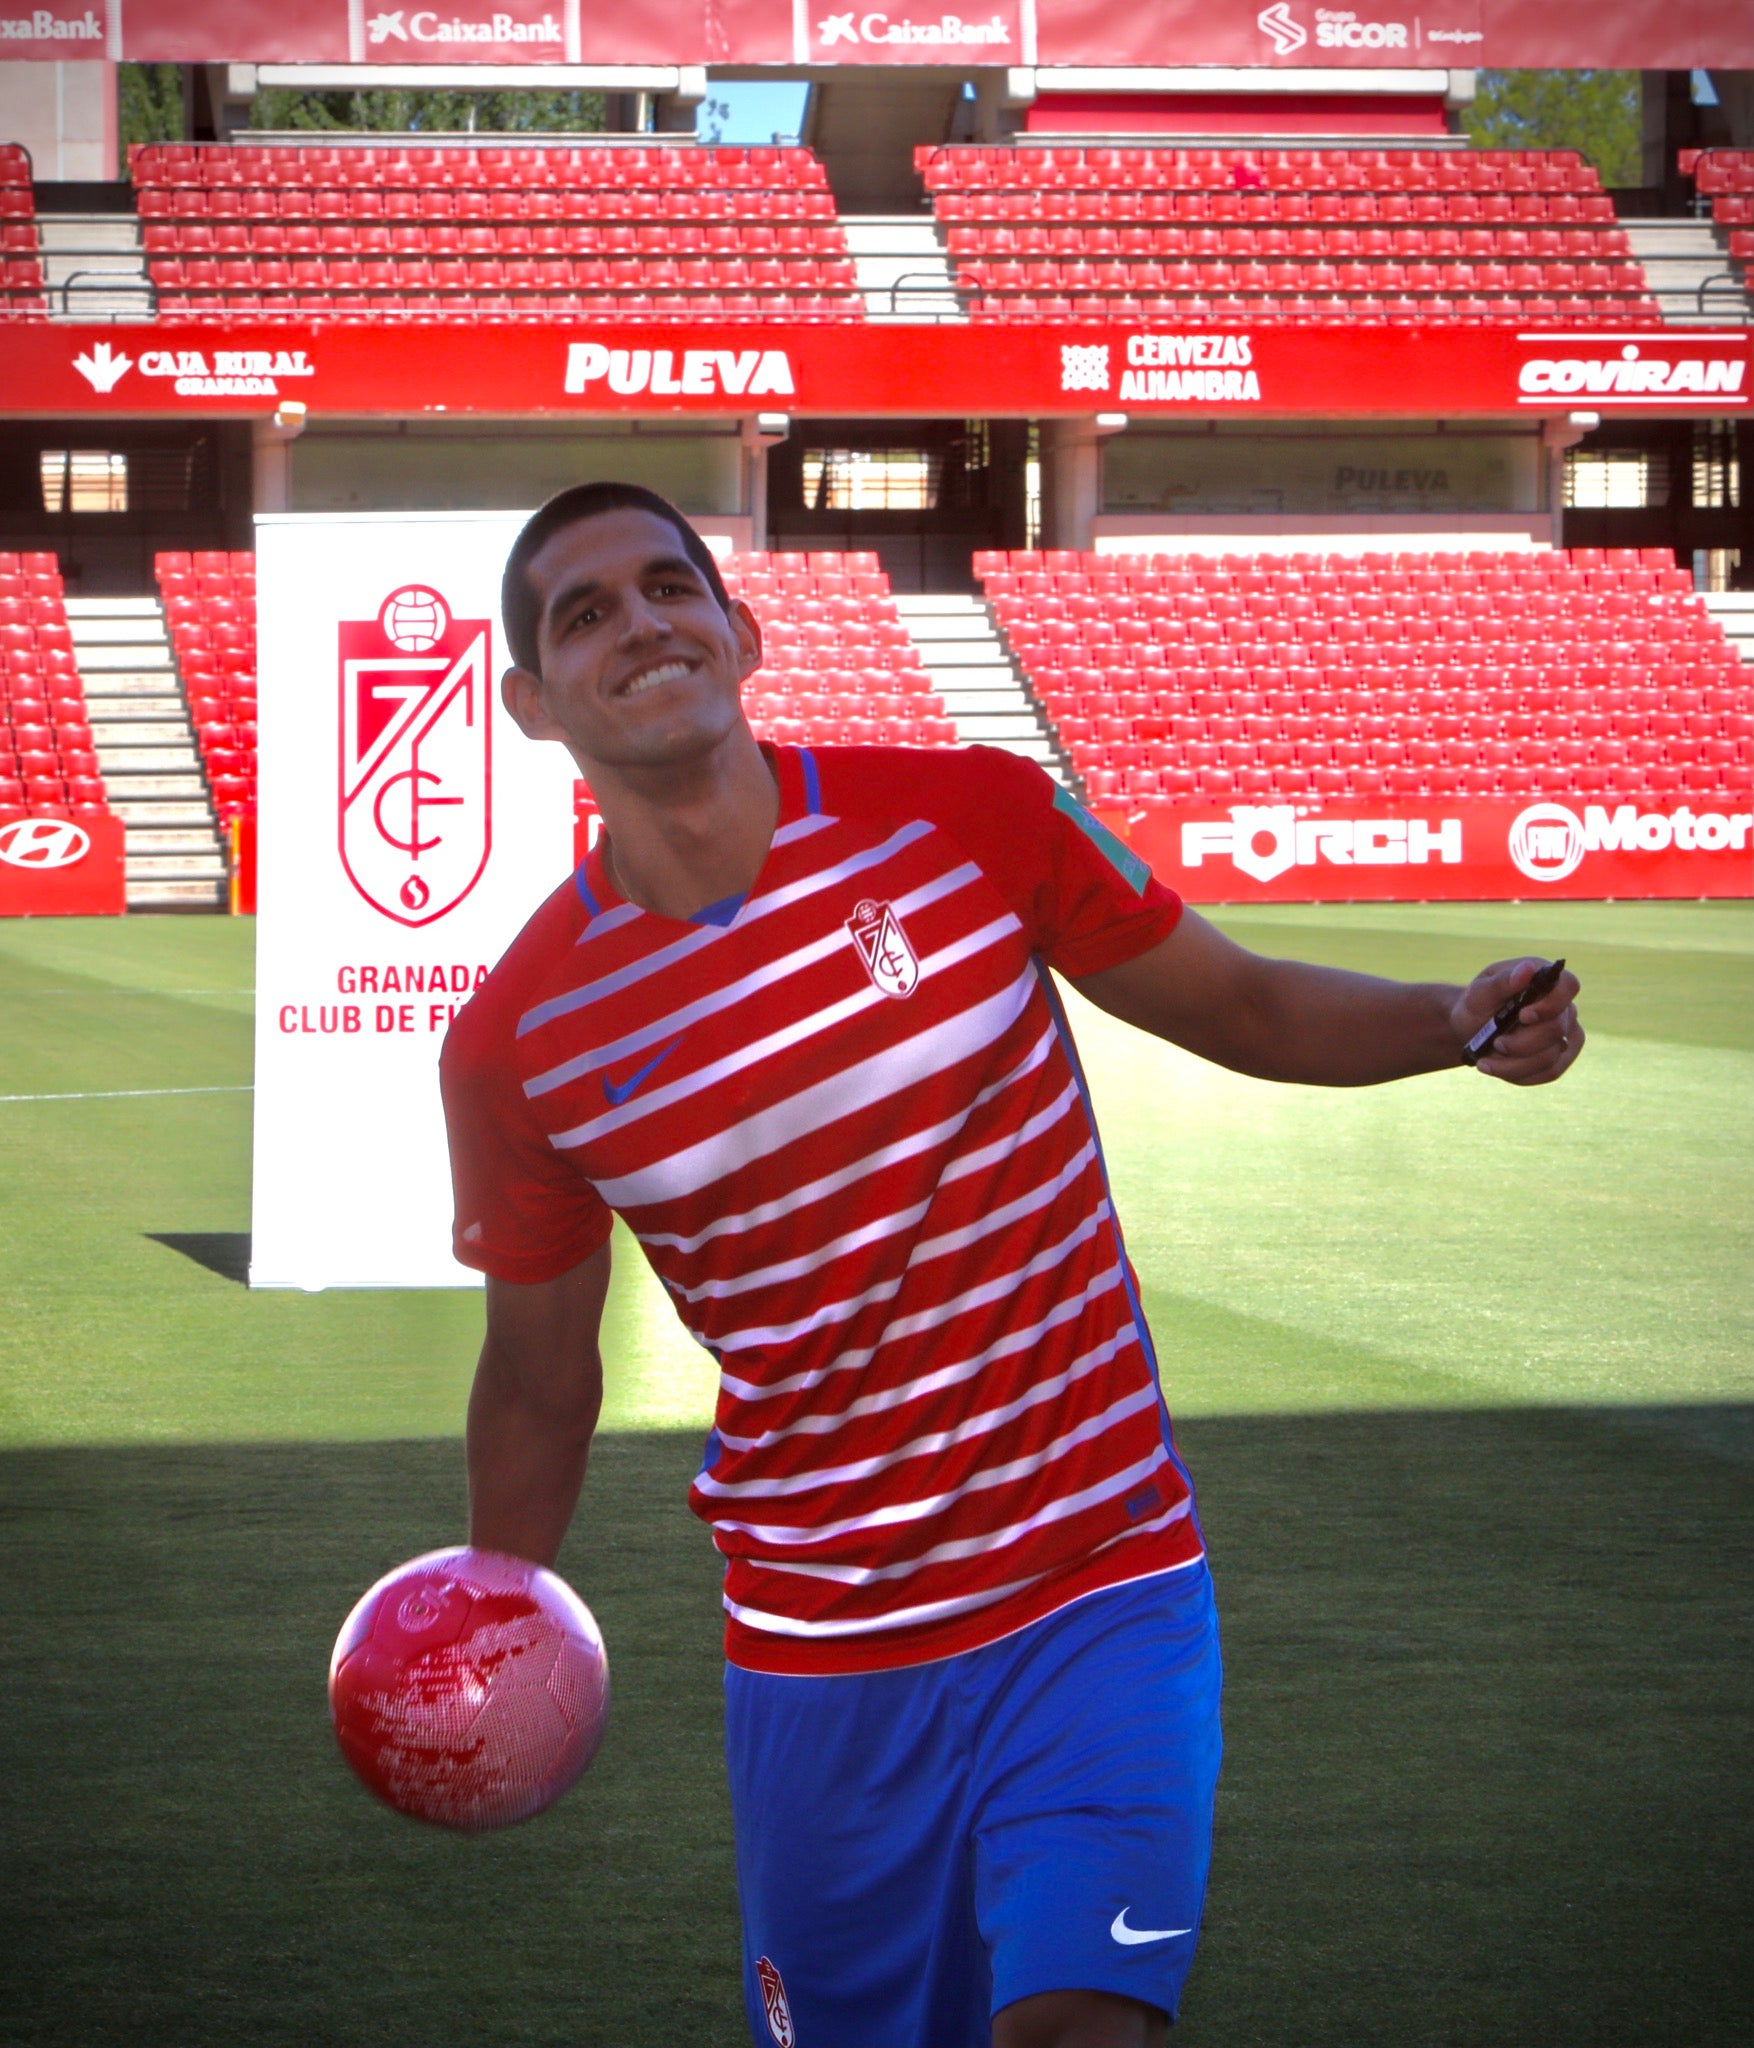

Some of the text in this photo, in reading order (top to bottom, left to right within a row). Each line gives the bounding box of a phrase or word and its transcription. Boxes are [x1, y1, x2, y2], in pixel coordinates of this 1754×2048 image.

[410, 11, 562, 44] CaixaBank
[860, 12, 1010, 45] CaixaBank
[1316, 22, 1408, 48] SICOR
[138, 351, 314, 376] CAJA RURAL
[1127, 335, 1252, 366] CERVEZAS
[564, 343, 795, 394] PULEVA
[174, 377, 278, 396] GRANADA
[1120, 370, 1260, 401] ALHAMBRA
[1335, 466, 1450, 492] PULEVA
[1585, 805, 1753, 851] Motor
[337, 965, 490, 994] GRANADA
[279, 1005, 362, 1033] CLUB
[376, 1005, 416, 1033] DE
